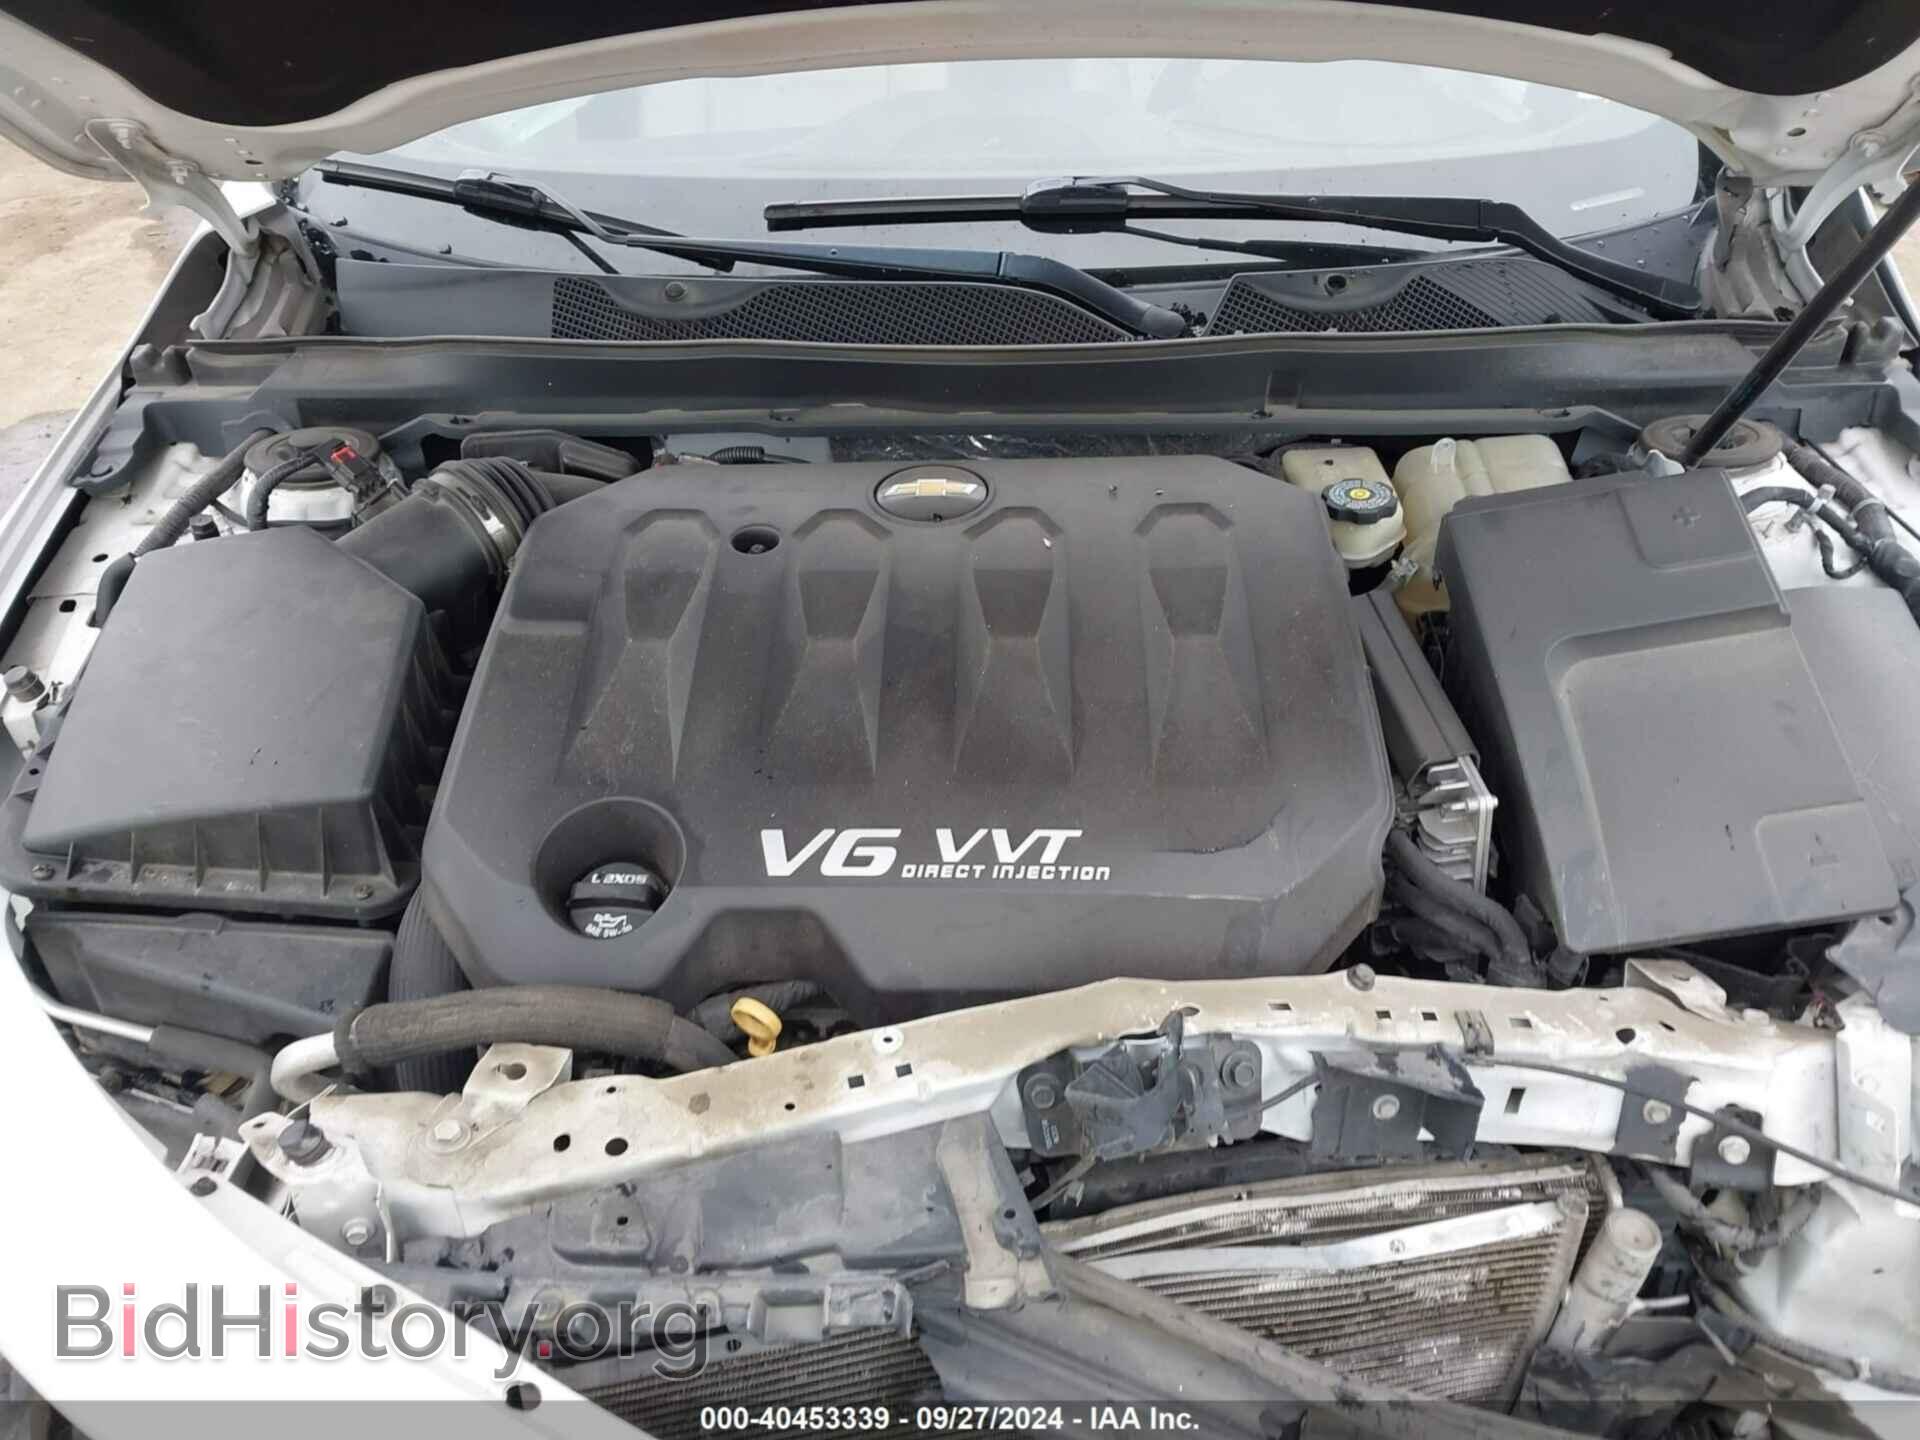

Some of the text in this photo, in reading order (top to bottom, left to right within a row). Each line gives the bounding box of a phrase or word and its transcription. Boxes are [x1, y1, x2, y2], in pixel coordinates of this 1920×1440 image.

[935, 828, 1083, 864] VVT
[901, 863, 1111, 881] DIRECT INJECTION
